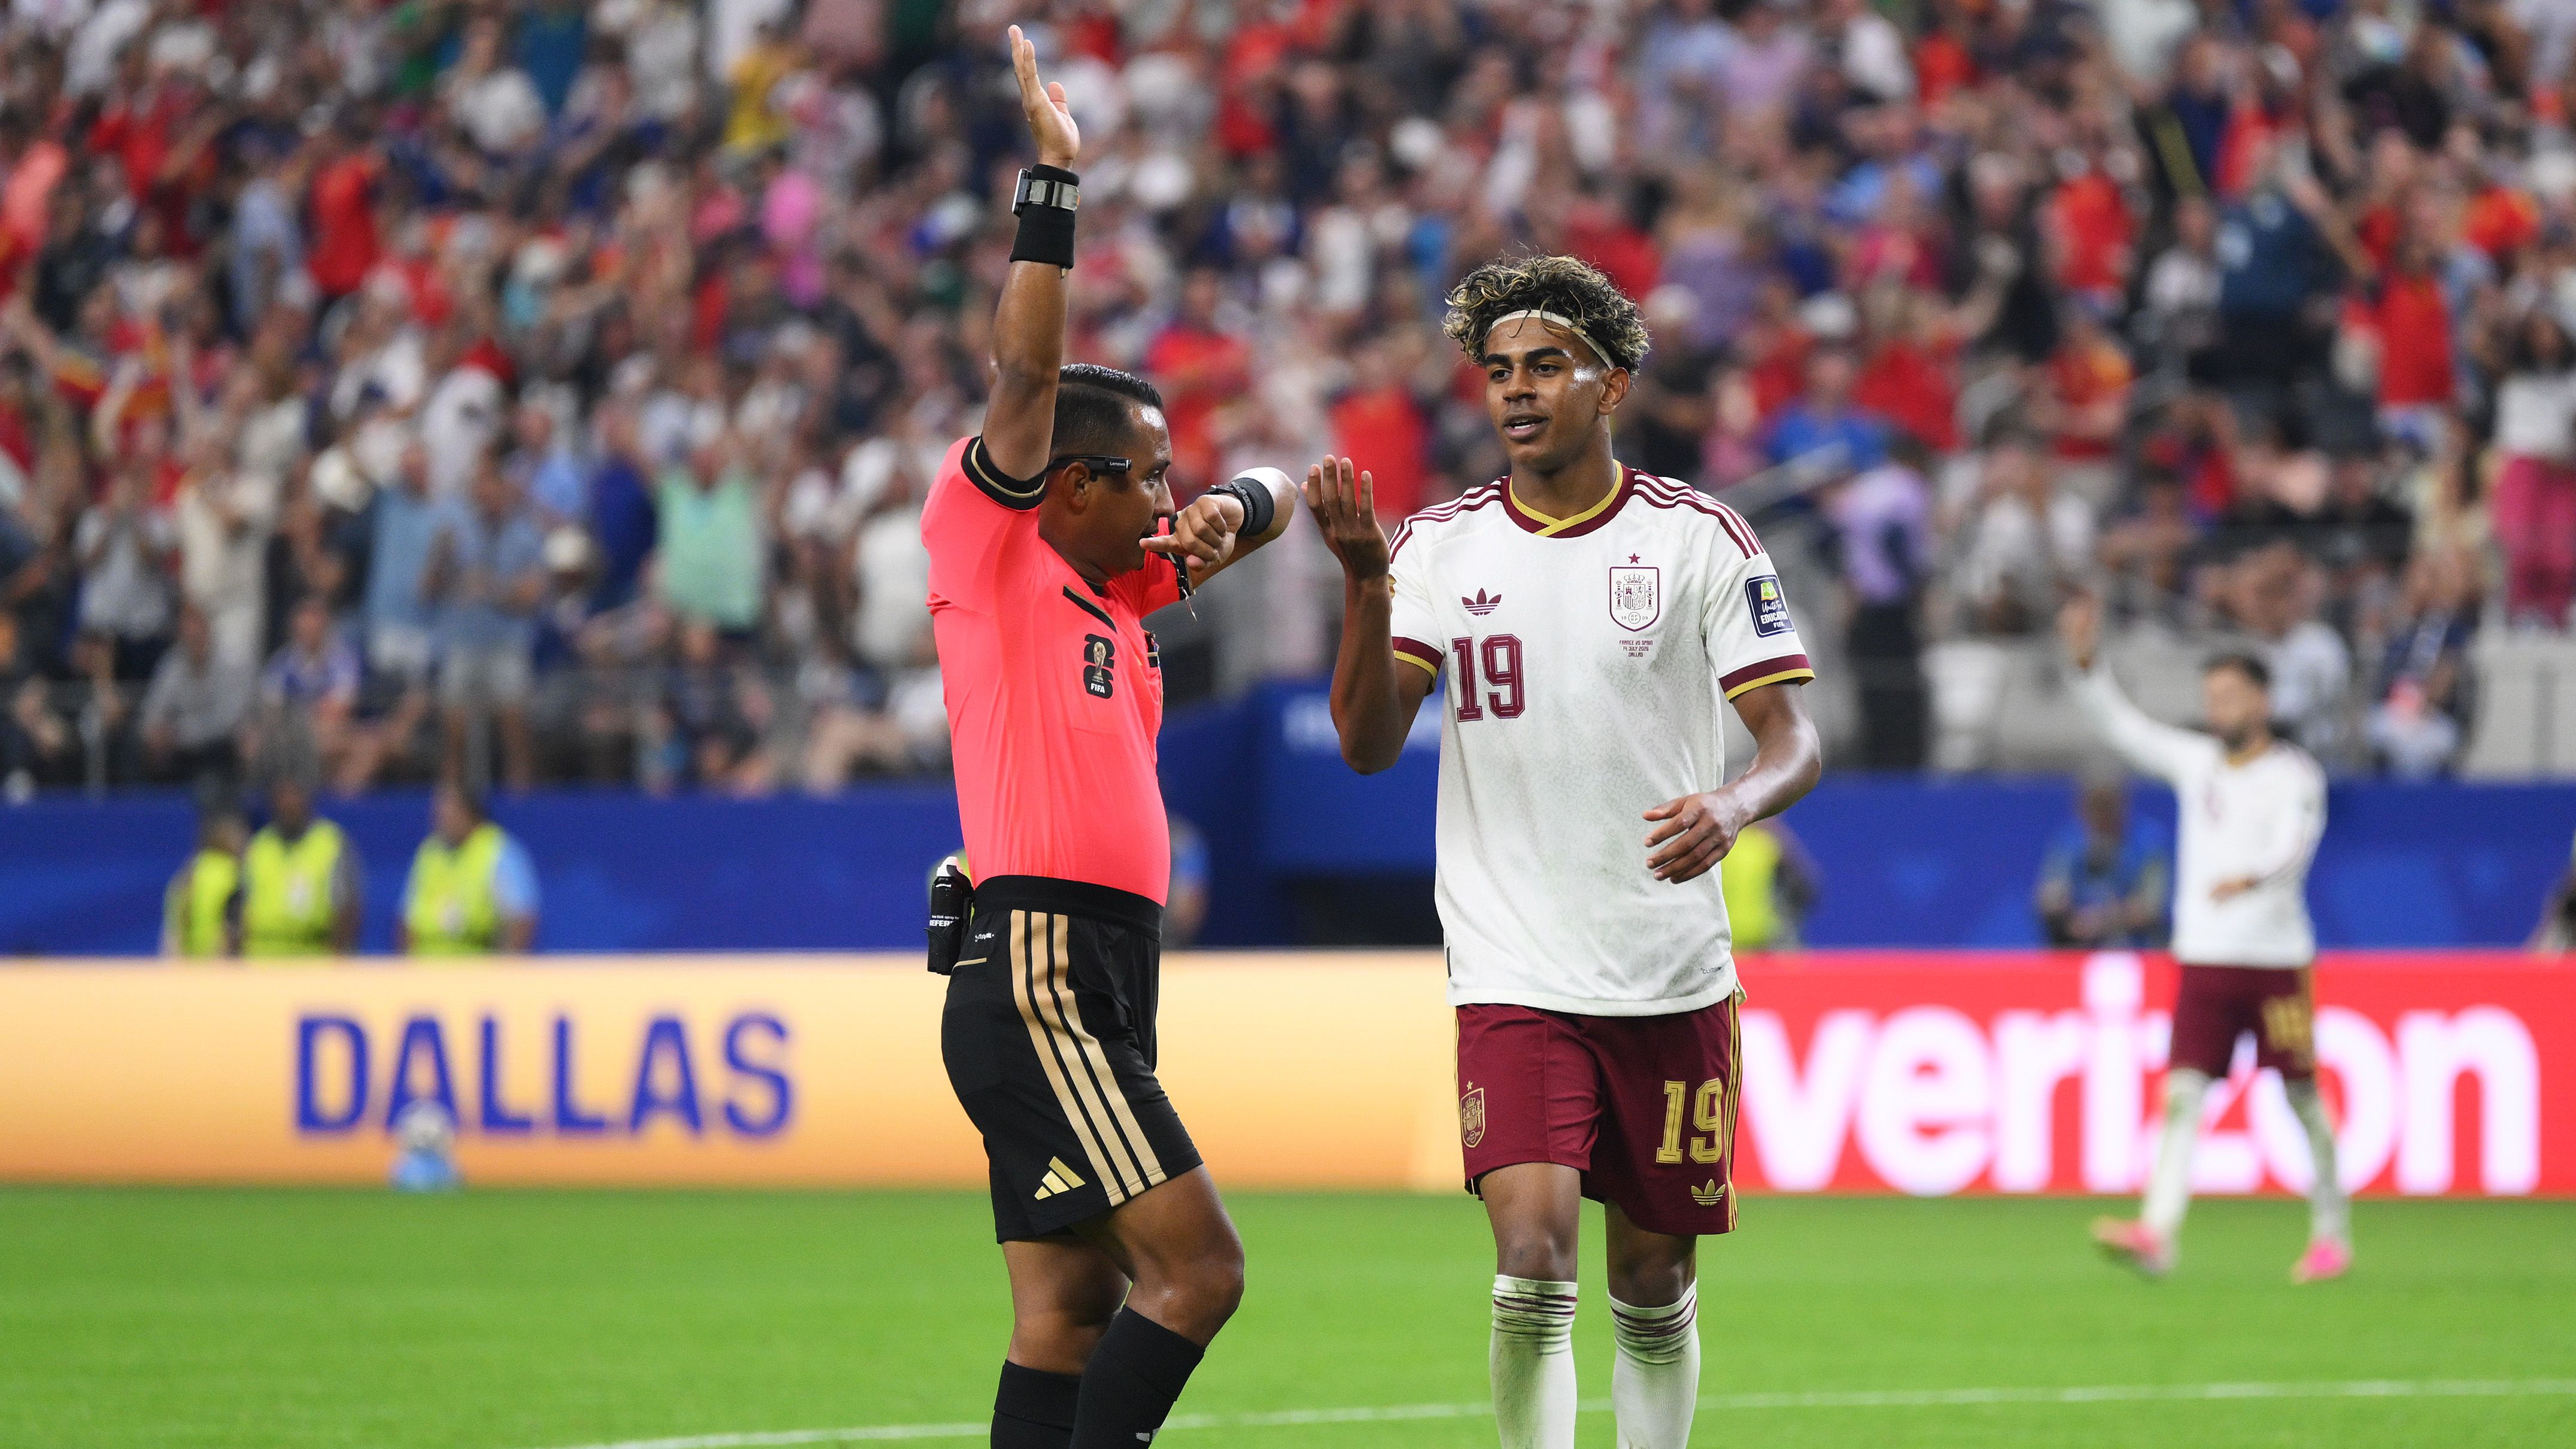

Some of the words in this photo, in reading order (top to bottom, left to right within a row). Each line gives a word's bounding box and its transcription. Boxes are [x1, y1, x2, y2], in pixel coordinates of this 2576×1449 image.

[1090, 683, 1105, 694] FIFA
[1452, 634, 1526, 722] 19
[297, 1013, 793, 1137] DALLAS
[1655, 1078, 1724, 1164] 19
